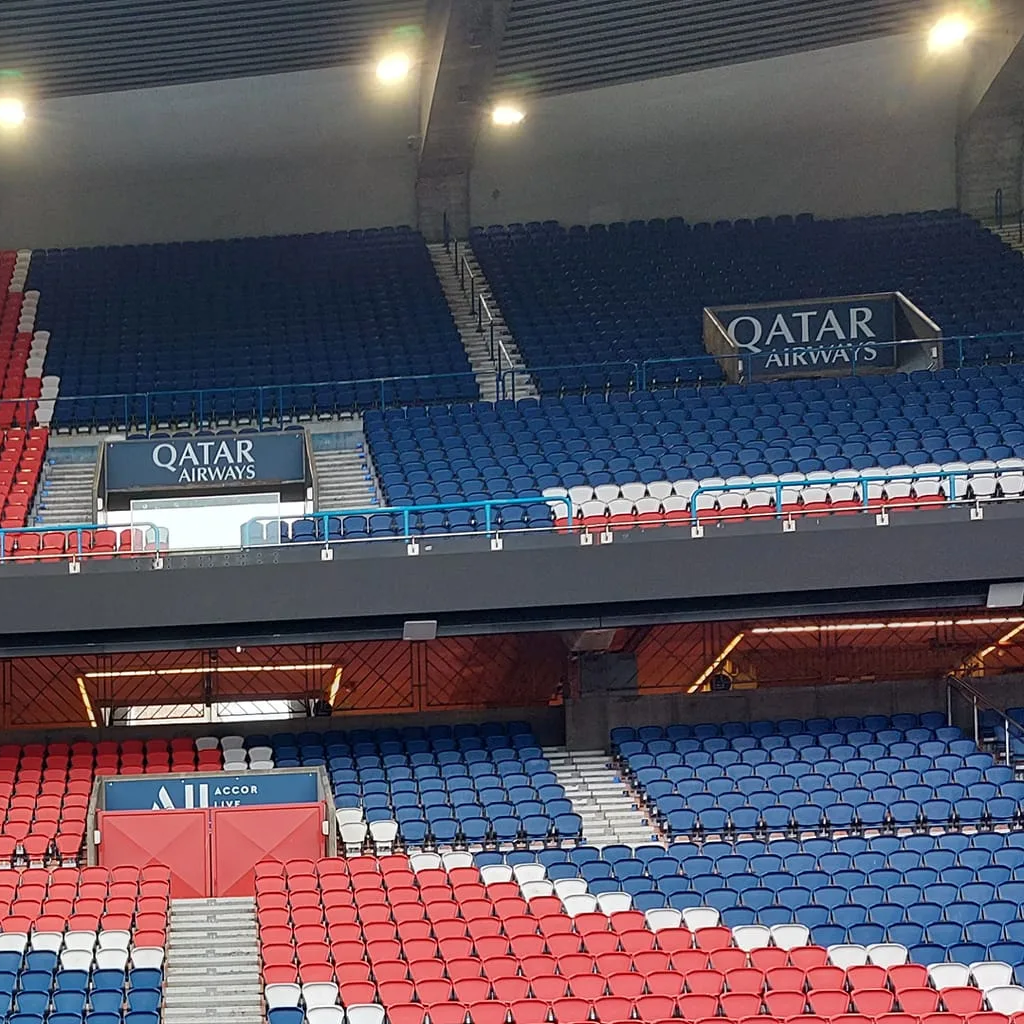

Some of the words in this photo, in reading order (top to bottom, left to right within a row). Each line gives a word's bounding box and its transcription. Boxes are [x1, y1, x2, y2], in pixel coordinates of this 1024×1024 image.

[728, 307, 876, 353] QATAR
[765, 341, 877, 368] AIRWAYS
[152, 440, 255, 472] QATAR
[178, 464, 256, 482] AIRWAYS
[214, 785, 258, 796] ACCOR
